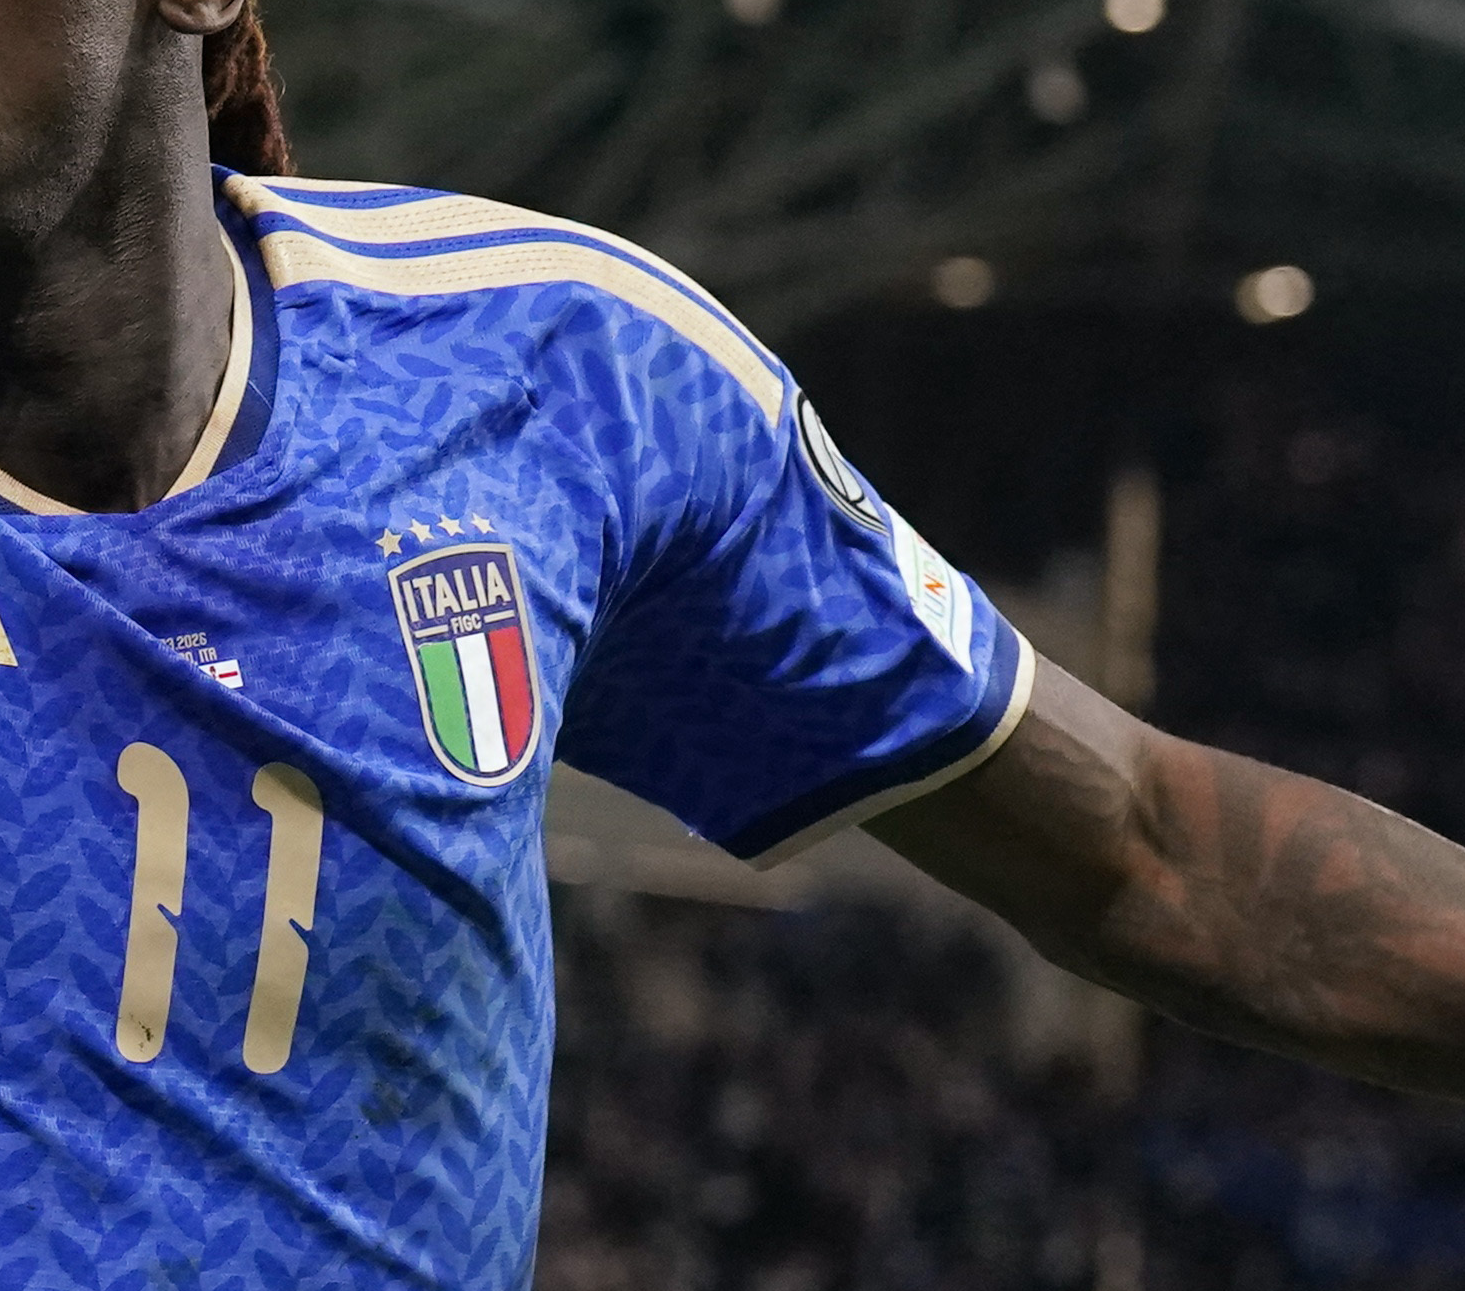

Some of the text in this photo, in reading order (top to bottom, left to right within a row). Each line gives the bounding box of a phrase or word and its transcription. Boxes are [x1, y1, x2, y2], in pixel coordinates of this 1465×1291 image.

[401, 561, 512, 623] ITALIA
[450, 614, 483, 634] FIGC
[116, 741, 324, 1075] 11
